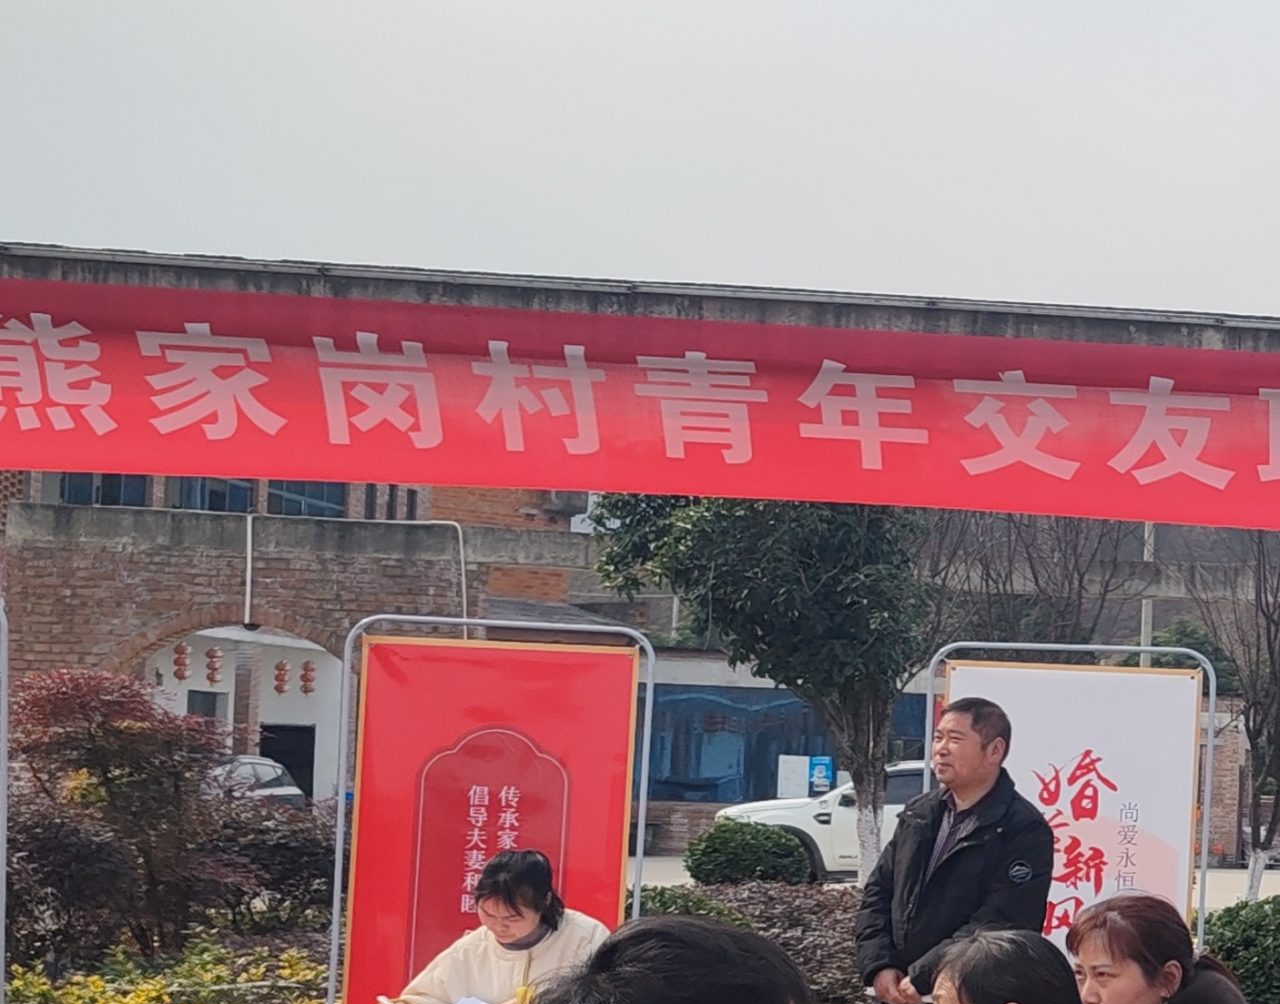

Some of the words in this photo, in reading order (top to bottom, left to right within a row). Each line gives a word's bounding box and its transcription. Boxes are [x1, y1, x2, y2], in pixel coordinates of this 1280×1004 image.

[496, 785, 521, 850] 传承家
[1114, 801, 1139, 893] 尚爱永恒
